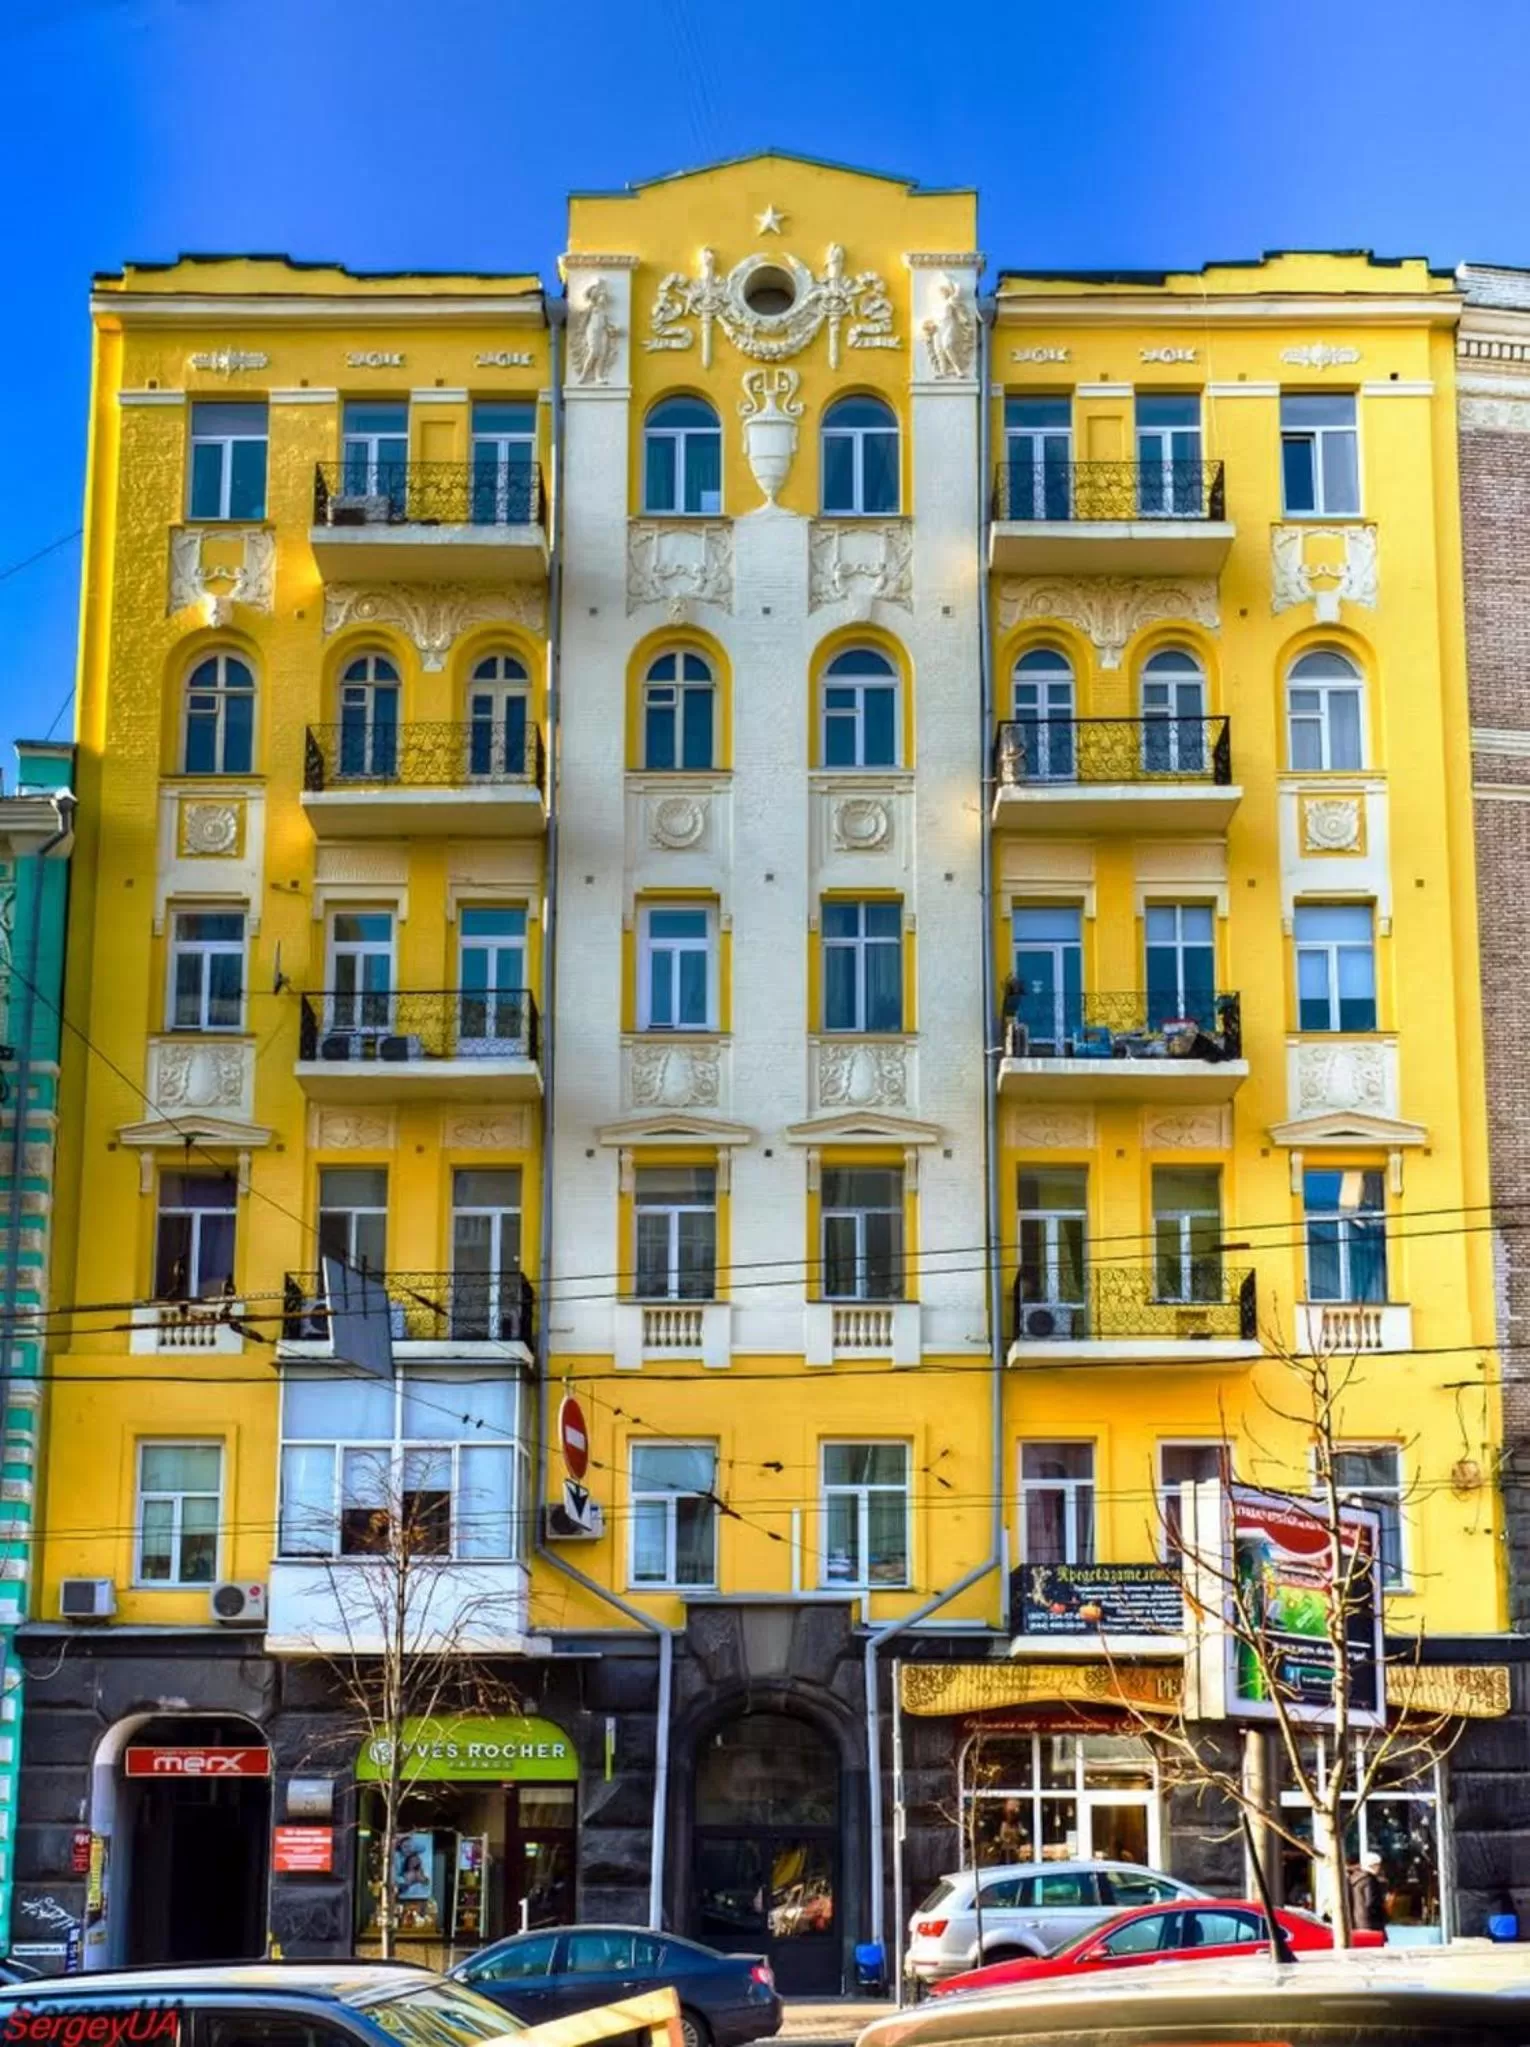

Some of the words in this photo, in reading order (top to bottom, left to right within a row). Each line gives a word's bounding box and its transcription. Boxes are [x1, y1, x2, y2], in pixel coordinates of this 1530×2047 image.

[400, 1743, 459, 1758] YVES
[468, 1743, 566, 1758] ROCHER
[153, 1752, 247, 1774] merx
